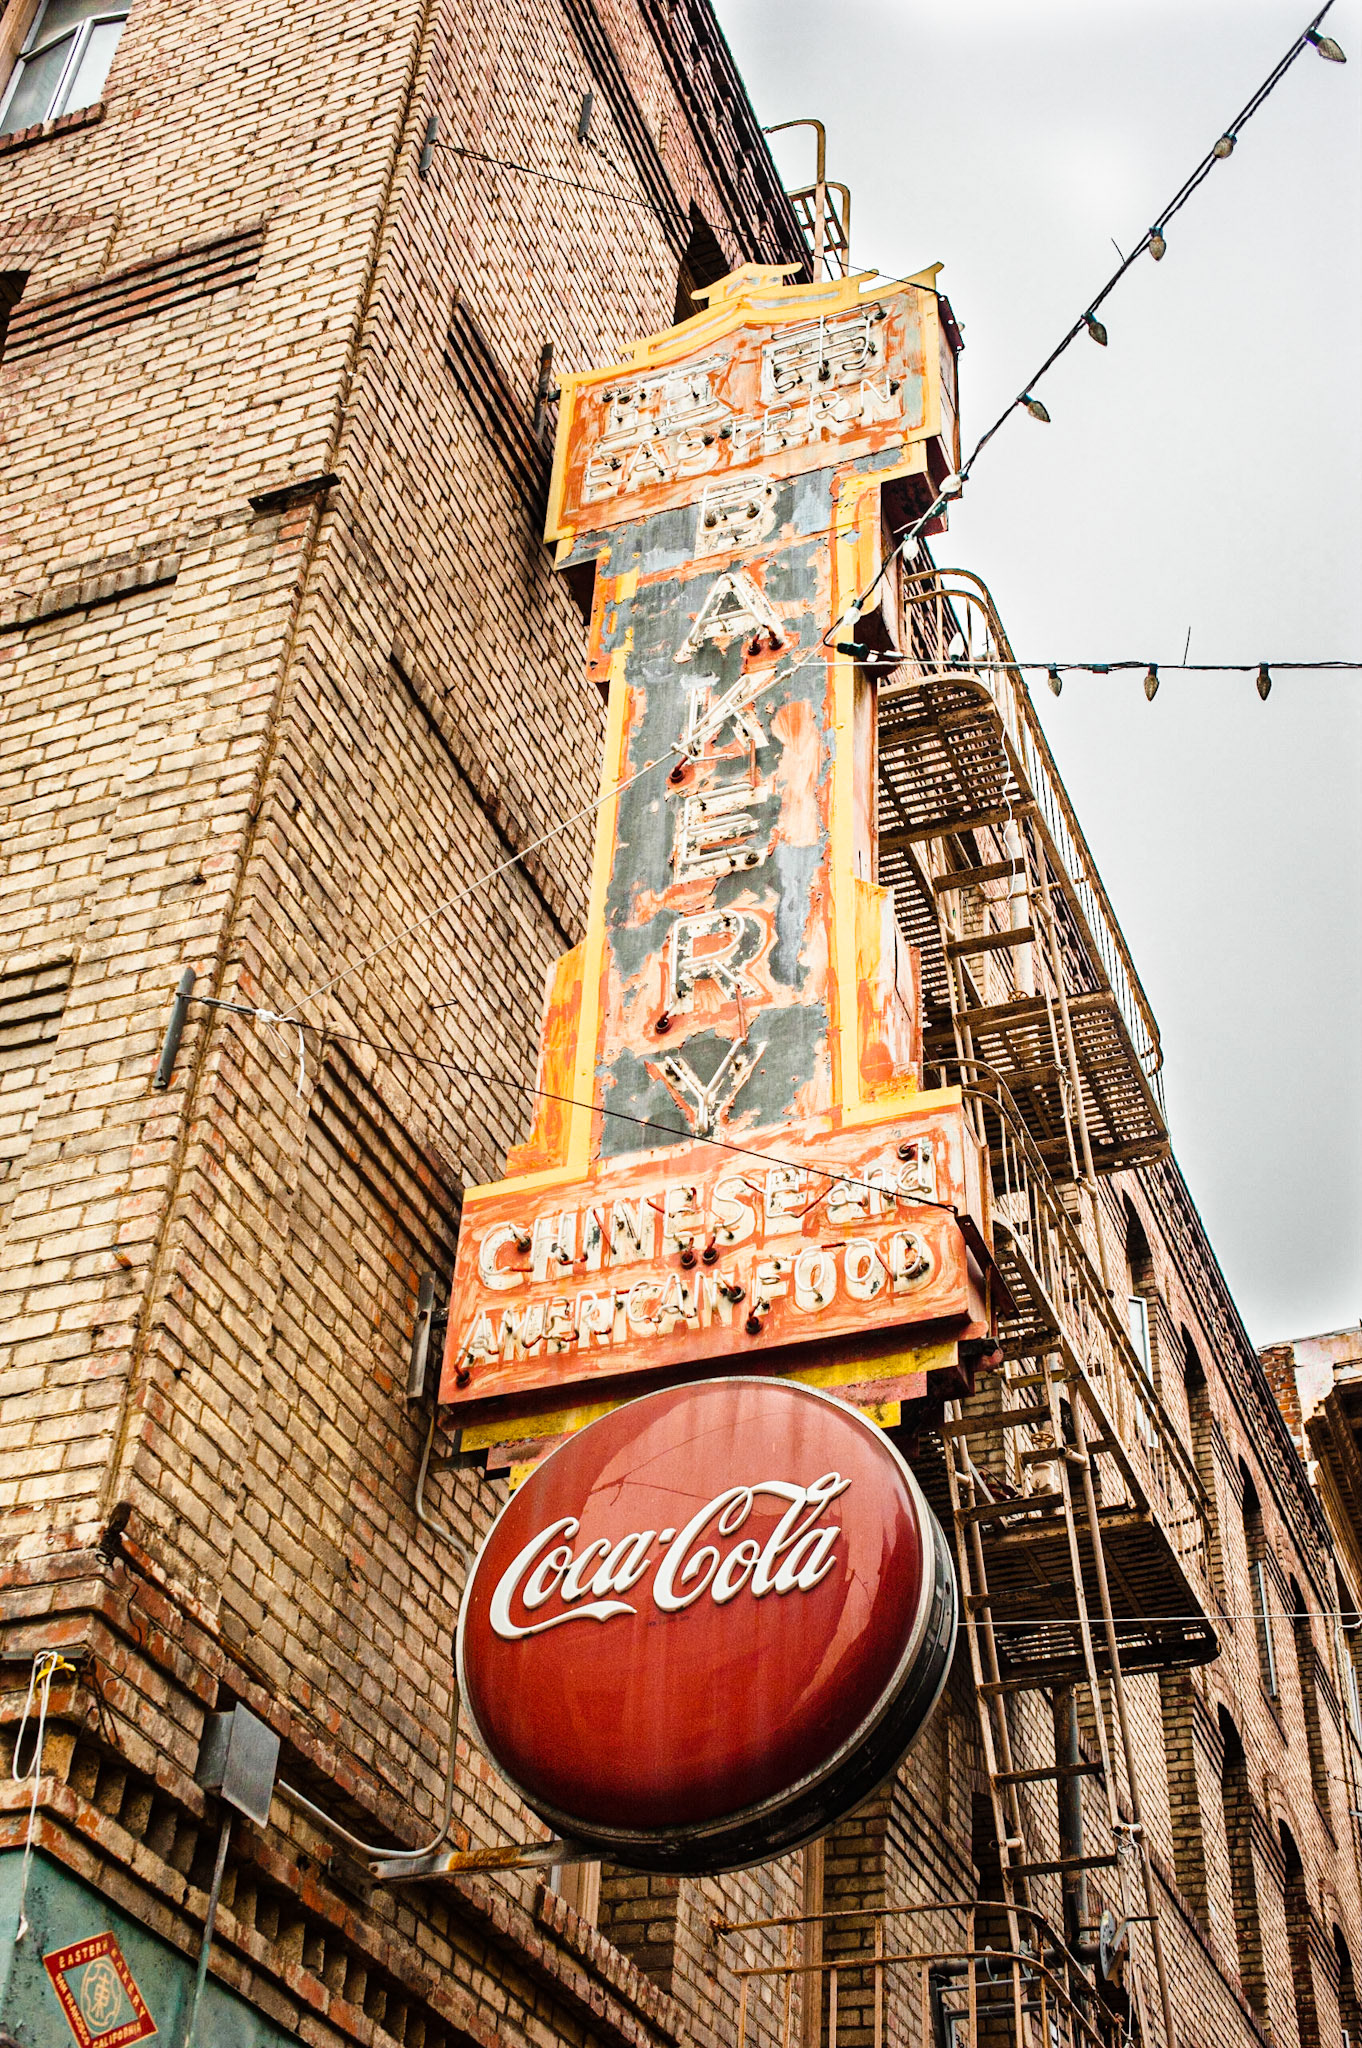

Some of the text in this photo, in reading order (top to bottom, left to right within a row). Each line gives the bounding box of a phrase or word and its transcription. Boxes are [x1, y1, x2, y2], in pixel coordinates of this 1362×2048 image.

[581, 374, 906, 504] EASTERN
[646, 474, 788, 1136] BAKERY
[478, 1138, 938, 1291] CHINESE and
[456, 1230, 937, 1369] AMERICAN FOOD
[488, 1471, 852, 1639] Coca-Cola
[58, 1938, 109, 1969] EASTERN
[92, 2021, 143, 2048] CALIFORNIA
